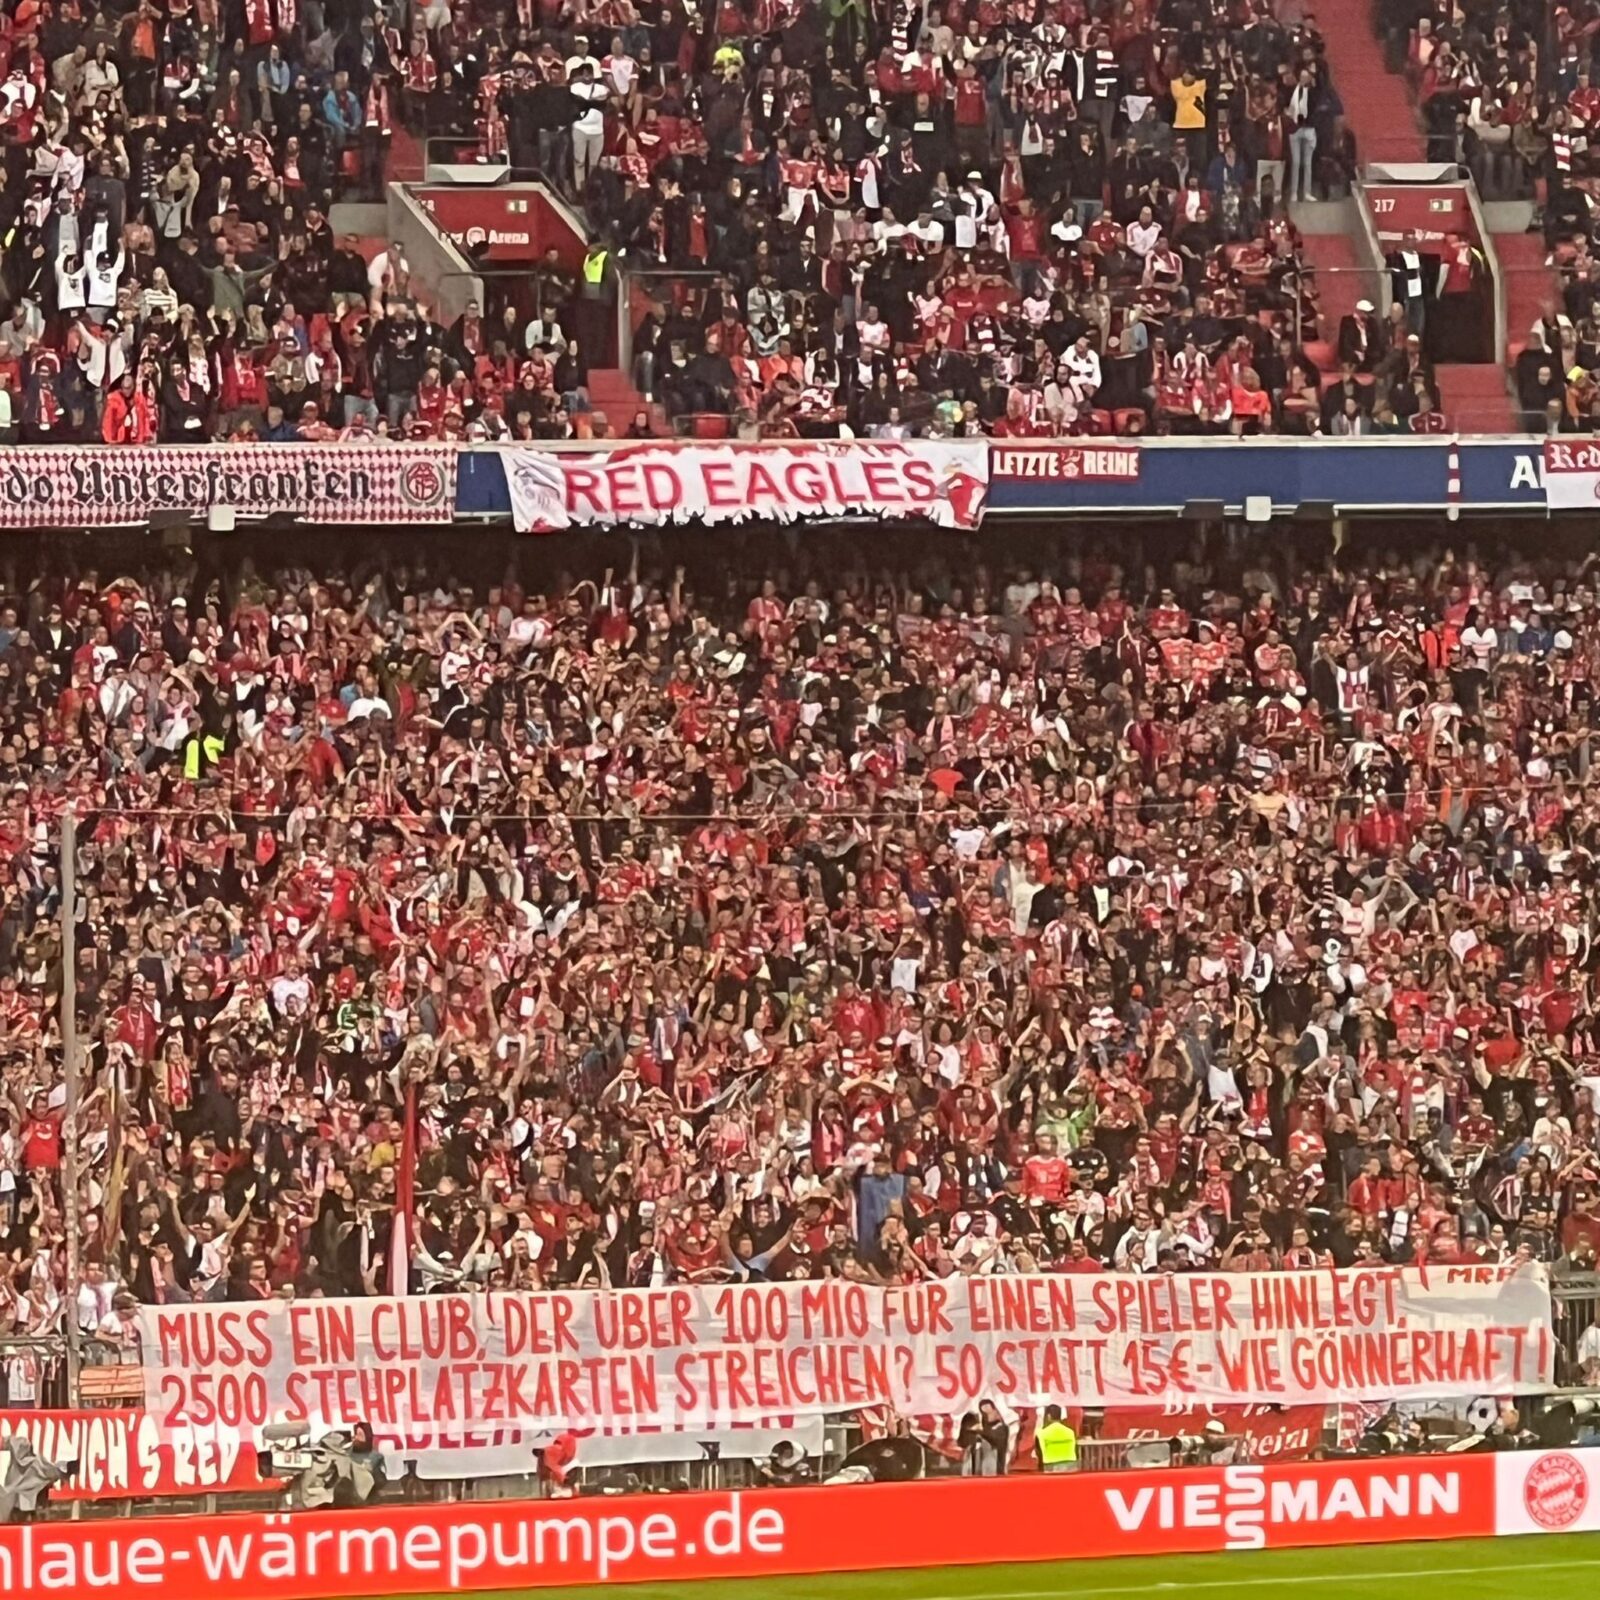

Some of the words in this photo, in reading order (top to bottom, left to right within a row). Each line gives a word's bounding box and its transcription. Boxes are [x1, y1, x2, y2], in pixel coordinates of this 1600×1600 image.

[562, 463, 683, 513] RED
[700, 460, 938, 507] EAGLES
[993, 450, 1059, 477] LETZTE
[1083, 450, 1139, 477] REIHE
[158, 1310, 272, 1368] MUSS
[290, 1304, 355, 1366] EIN
[371, 1297, 487, 1361] CLUB,
[503, 1295, 580, 1357] DER
[593, 1290, 698, 1350] ÜBER
[715, 1287, 789, 1343] 100
[801, 1283, 869, 1339] MIO
[968, 1278, 1076, 1332] EINEN
[1092, 1277, 1238, 1333] SPIELER
[161, 1371, 267, 1427] 2500
[285, 1355, 660, 1425] STEHPLATZKARTEN
[936, 1343, 983, 1398] 50
[996, 1338, 1107, 1396] STATT
[171, 1425, 240, 1487] RED
[1104, 1464, 1460, 1550] VIESSMANN
